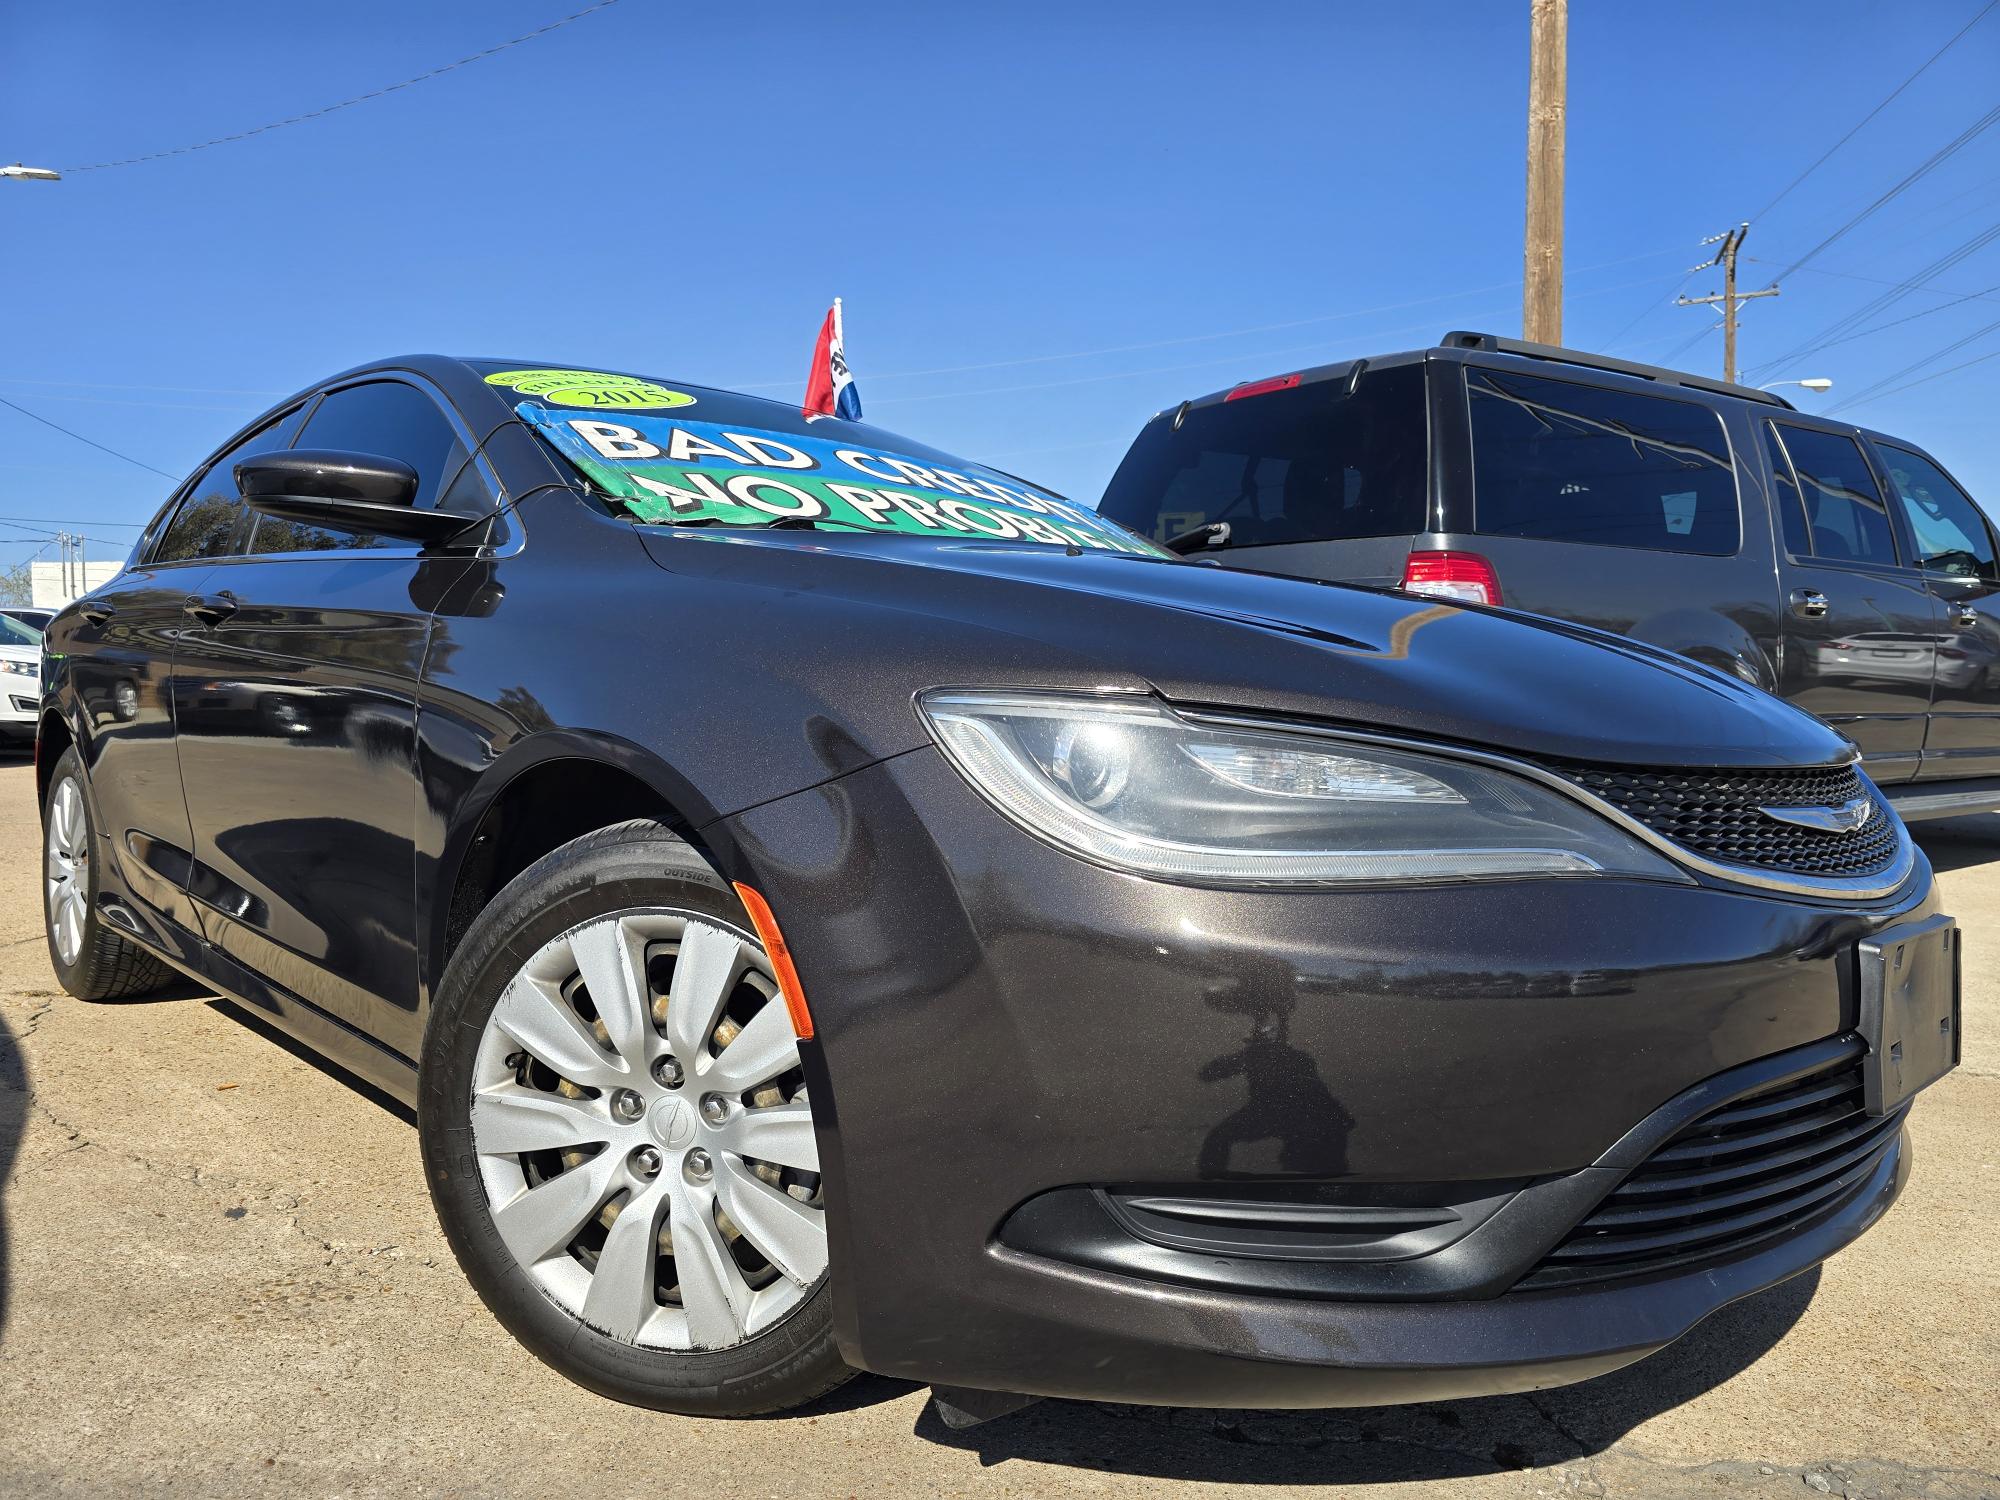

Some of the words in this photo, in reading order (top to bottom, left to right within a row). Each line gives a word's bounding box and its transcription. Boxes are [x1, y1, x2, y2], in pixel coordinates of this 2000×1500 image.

[577, 390, 671, 405] 2015
[567, 419, 822, 471] BAD
[832, 449, 1106, 532] CREDIT
[627, 472, 831, 519] NO
[663, 868, 712, 883] OUTSIDE
